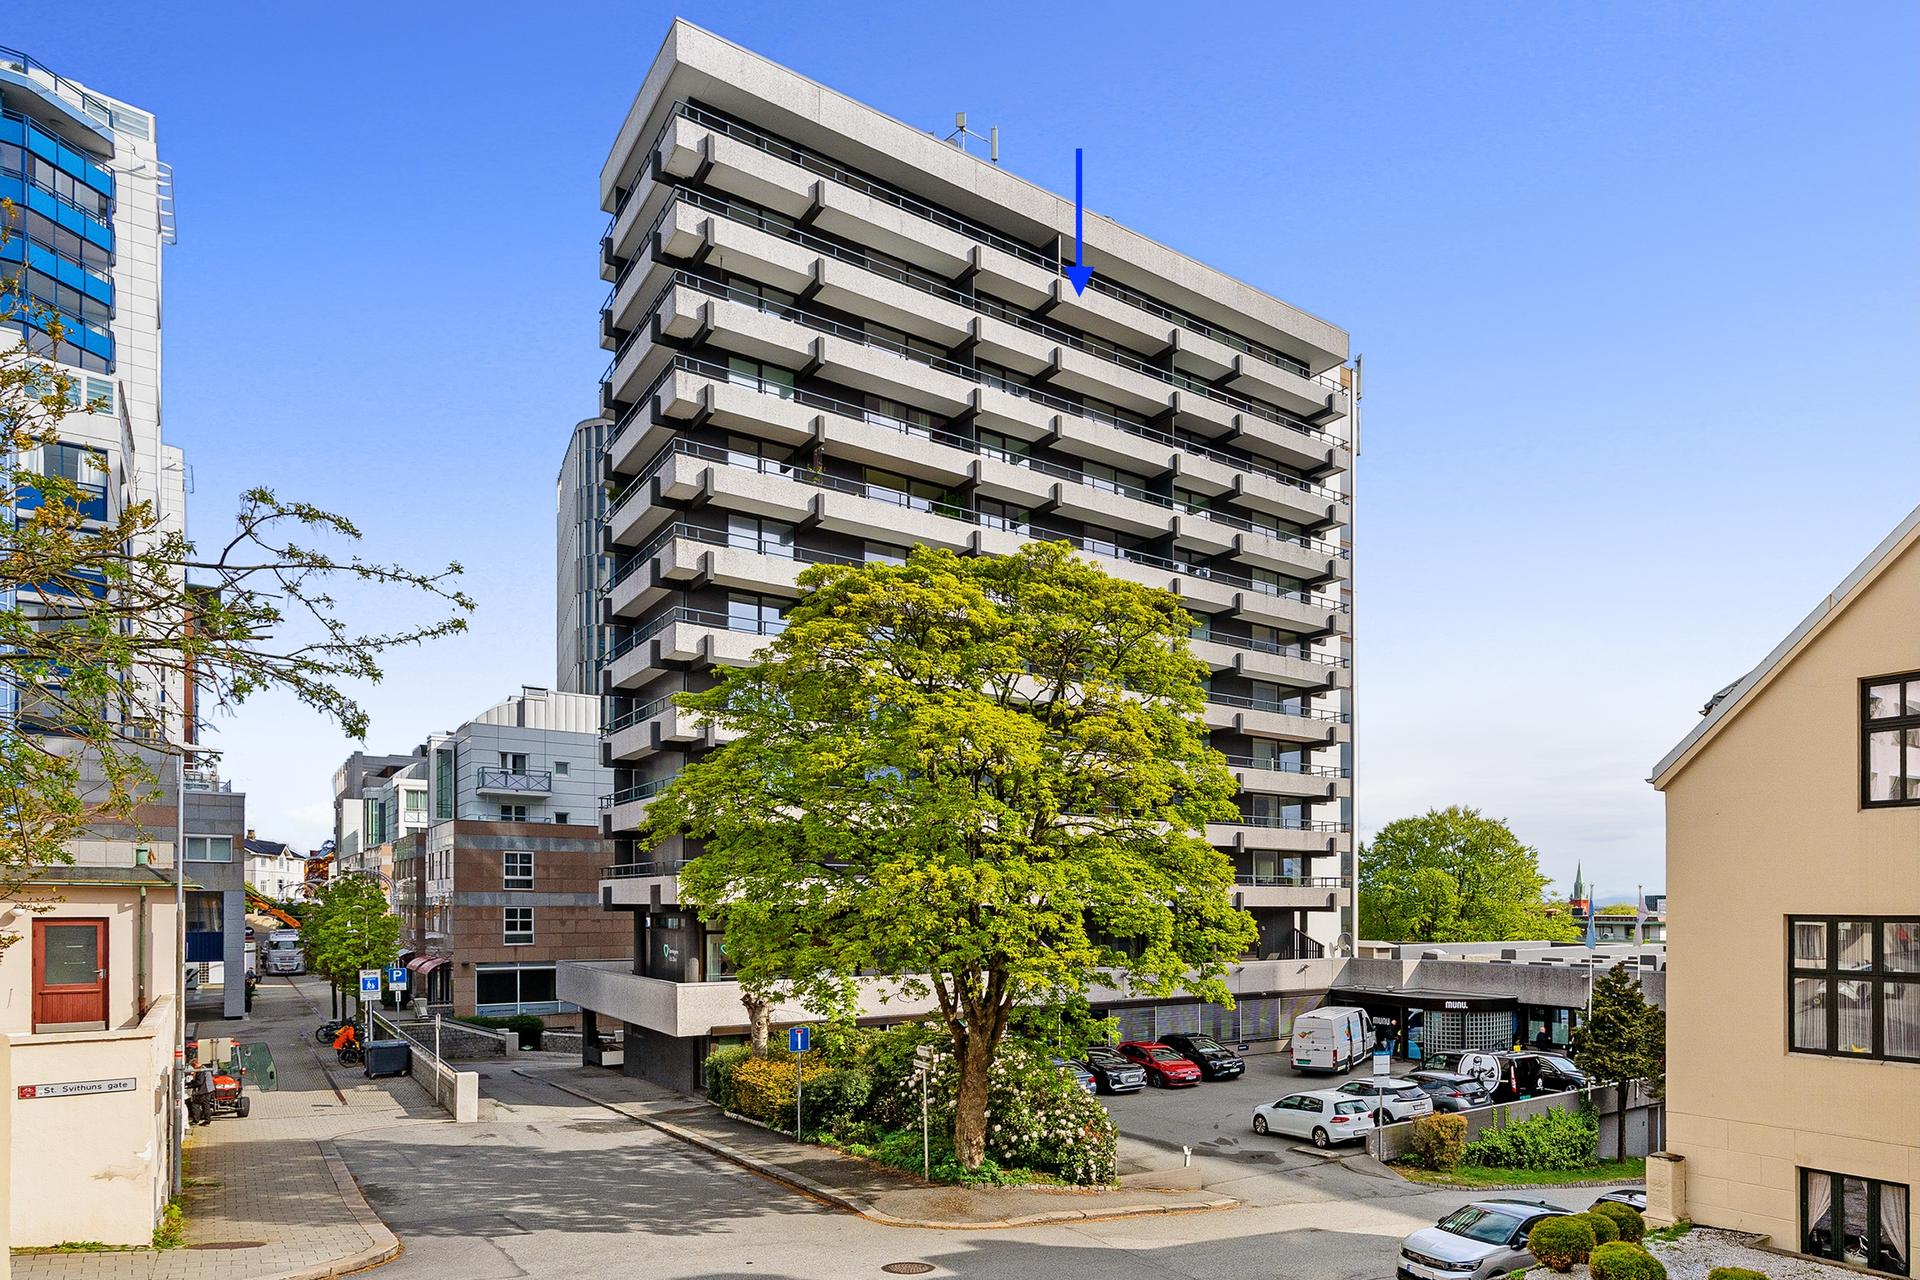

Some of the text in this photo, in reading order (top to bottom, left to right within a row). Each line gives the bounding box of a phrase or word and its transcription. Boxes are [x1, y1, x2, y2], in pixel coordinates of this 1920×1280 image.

[393, 970, 402, 981] P
[44, 1080, 128, 1094] St. Svithuns gate
